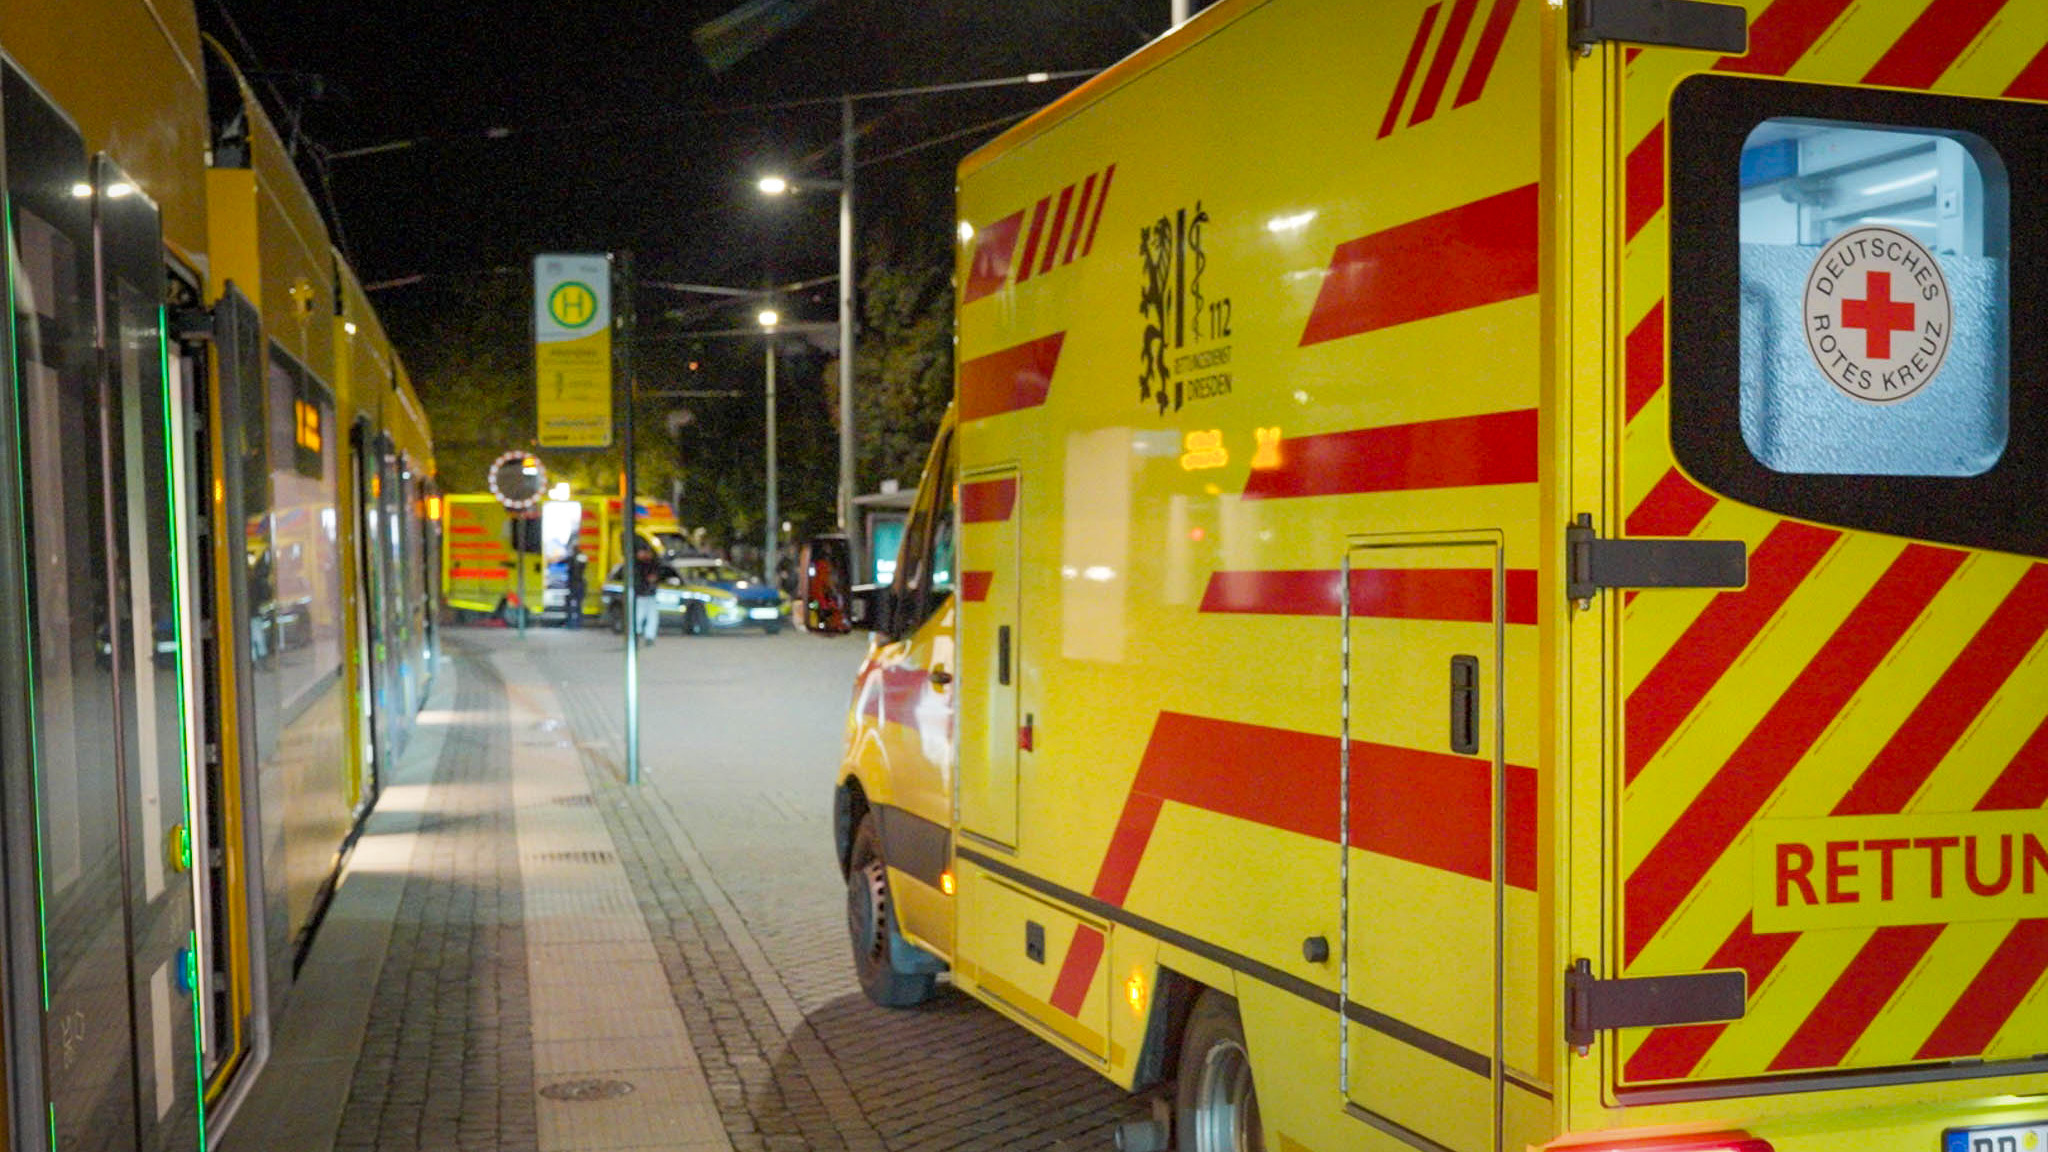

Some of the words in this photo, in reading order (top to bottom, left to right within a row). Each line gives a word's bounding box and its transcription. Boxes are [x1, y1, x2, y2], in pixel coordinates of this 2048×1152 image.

[1816, 238, 1939, 301] DEUTSCHES
[563, 291, 583, 318] H
[1209, 298, 1232, 340] 112
[1813, 314, 1872, 390] ROTES
[1882, 320, 1943, 391] KREUZ
